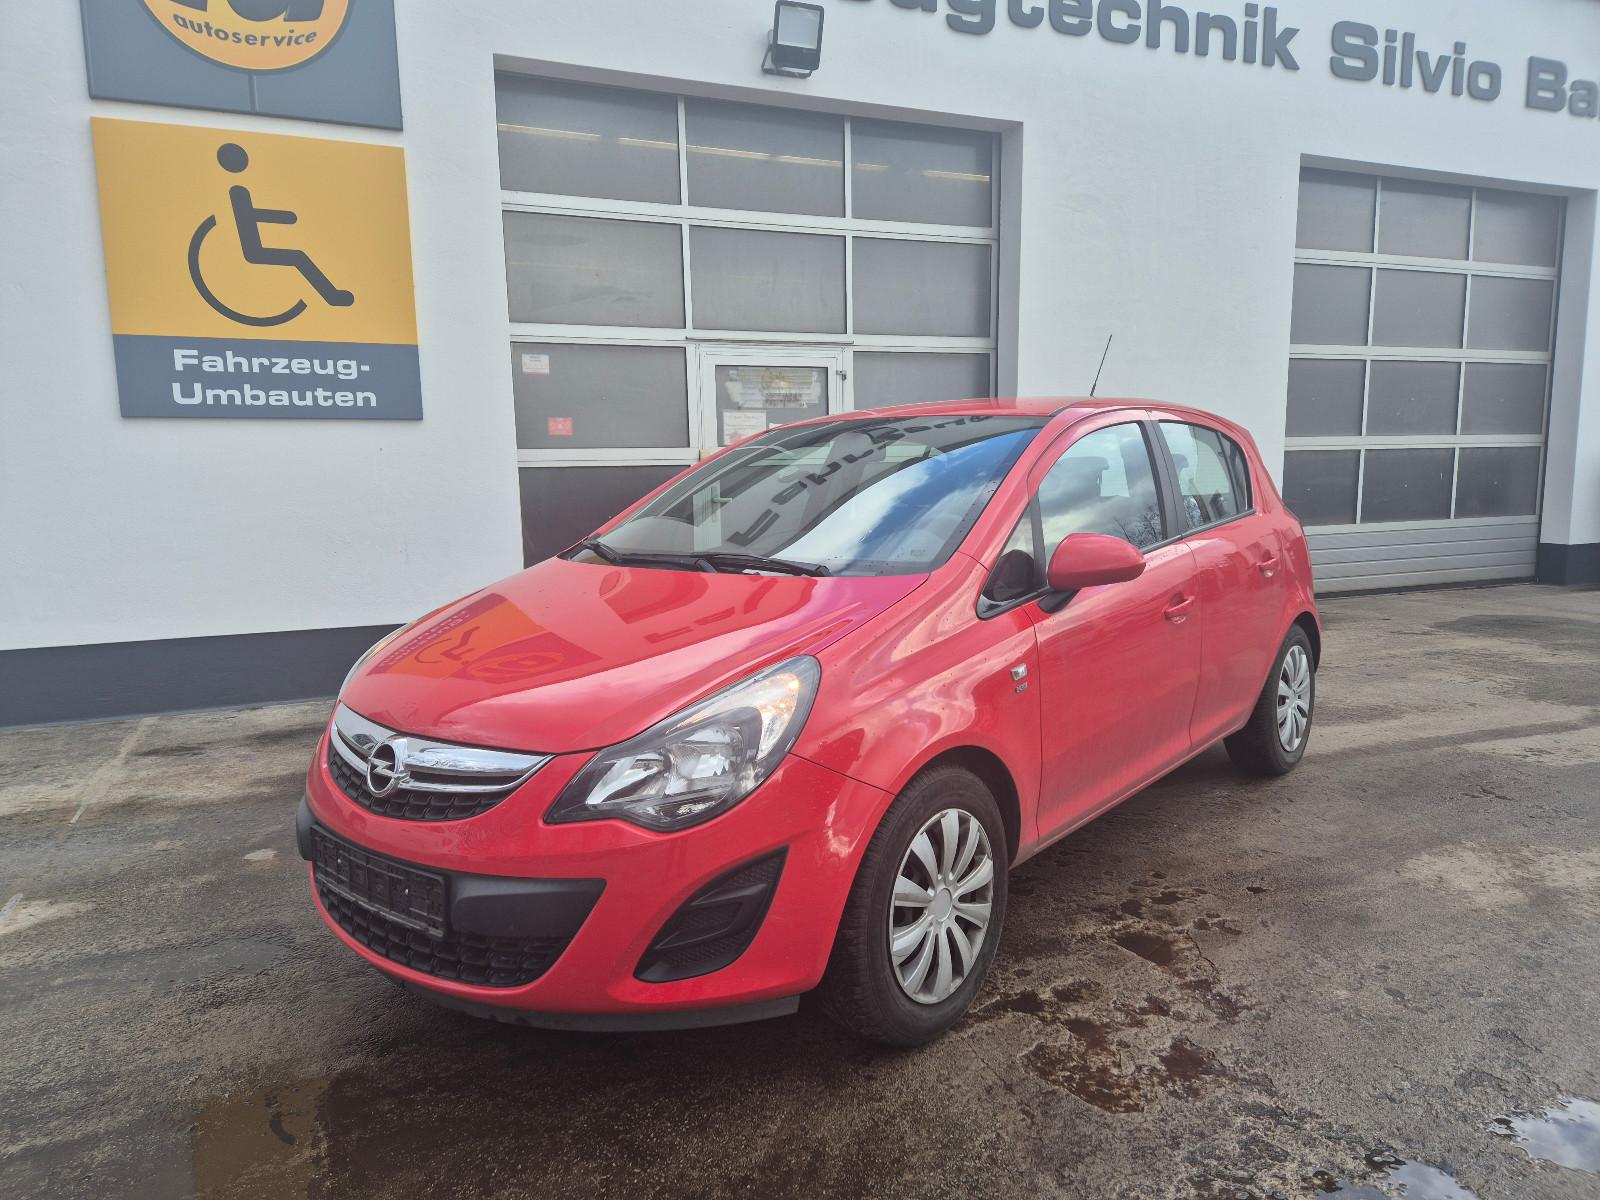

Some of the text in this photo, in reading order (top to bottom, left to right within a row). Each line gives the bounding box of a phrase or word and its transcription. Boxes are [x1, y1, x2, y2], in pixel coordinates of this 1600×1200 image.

[172, 13, 318, 47] autoservice
[1329, 20, 1502, 102] Silvio
[1525, 55, 1600, 120] Ba
[173, 348, 370, 380] Fahrzeug-
[171, 382, 377, 407] Umbauten
